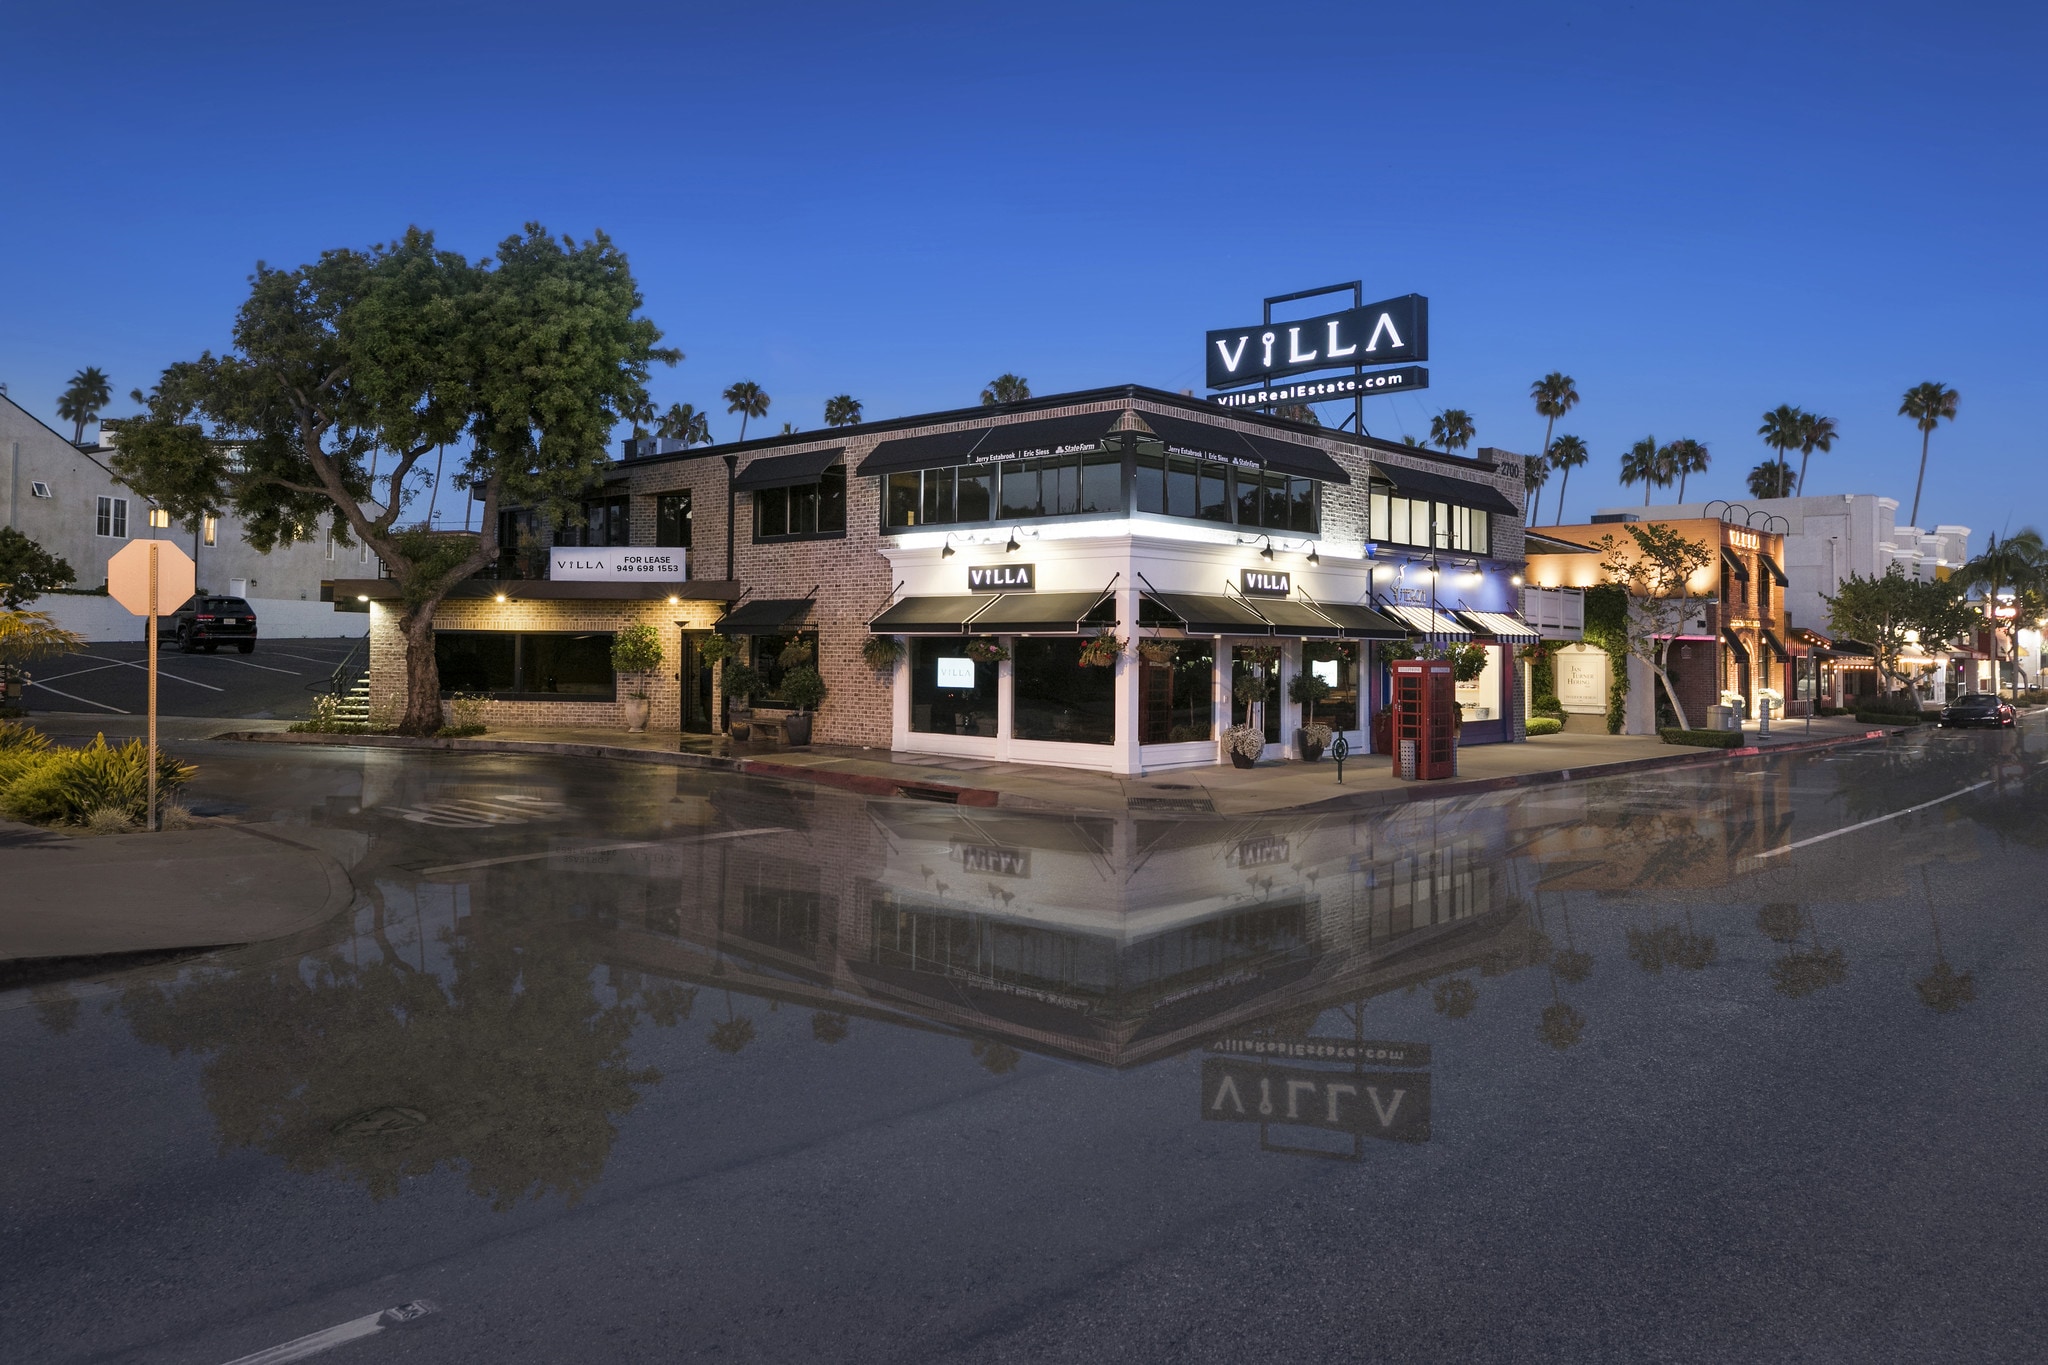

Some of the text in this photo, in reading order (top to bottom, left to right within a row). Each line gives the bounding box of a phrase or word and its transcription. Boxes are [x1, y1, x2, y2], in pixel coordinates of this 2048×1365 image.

[1216, 313, 1404, 372] VILLA
[1218, 373, 1402, 406] VillaRealEstate.com
[1501, 462, 1519, 478] 2700
[972, 568, 1028, 585] VILLA
[1247, 573, 1288, 590] VILLA
